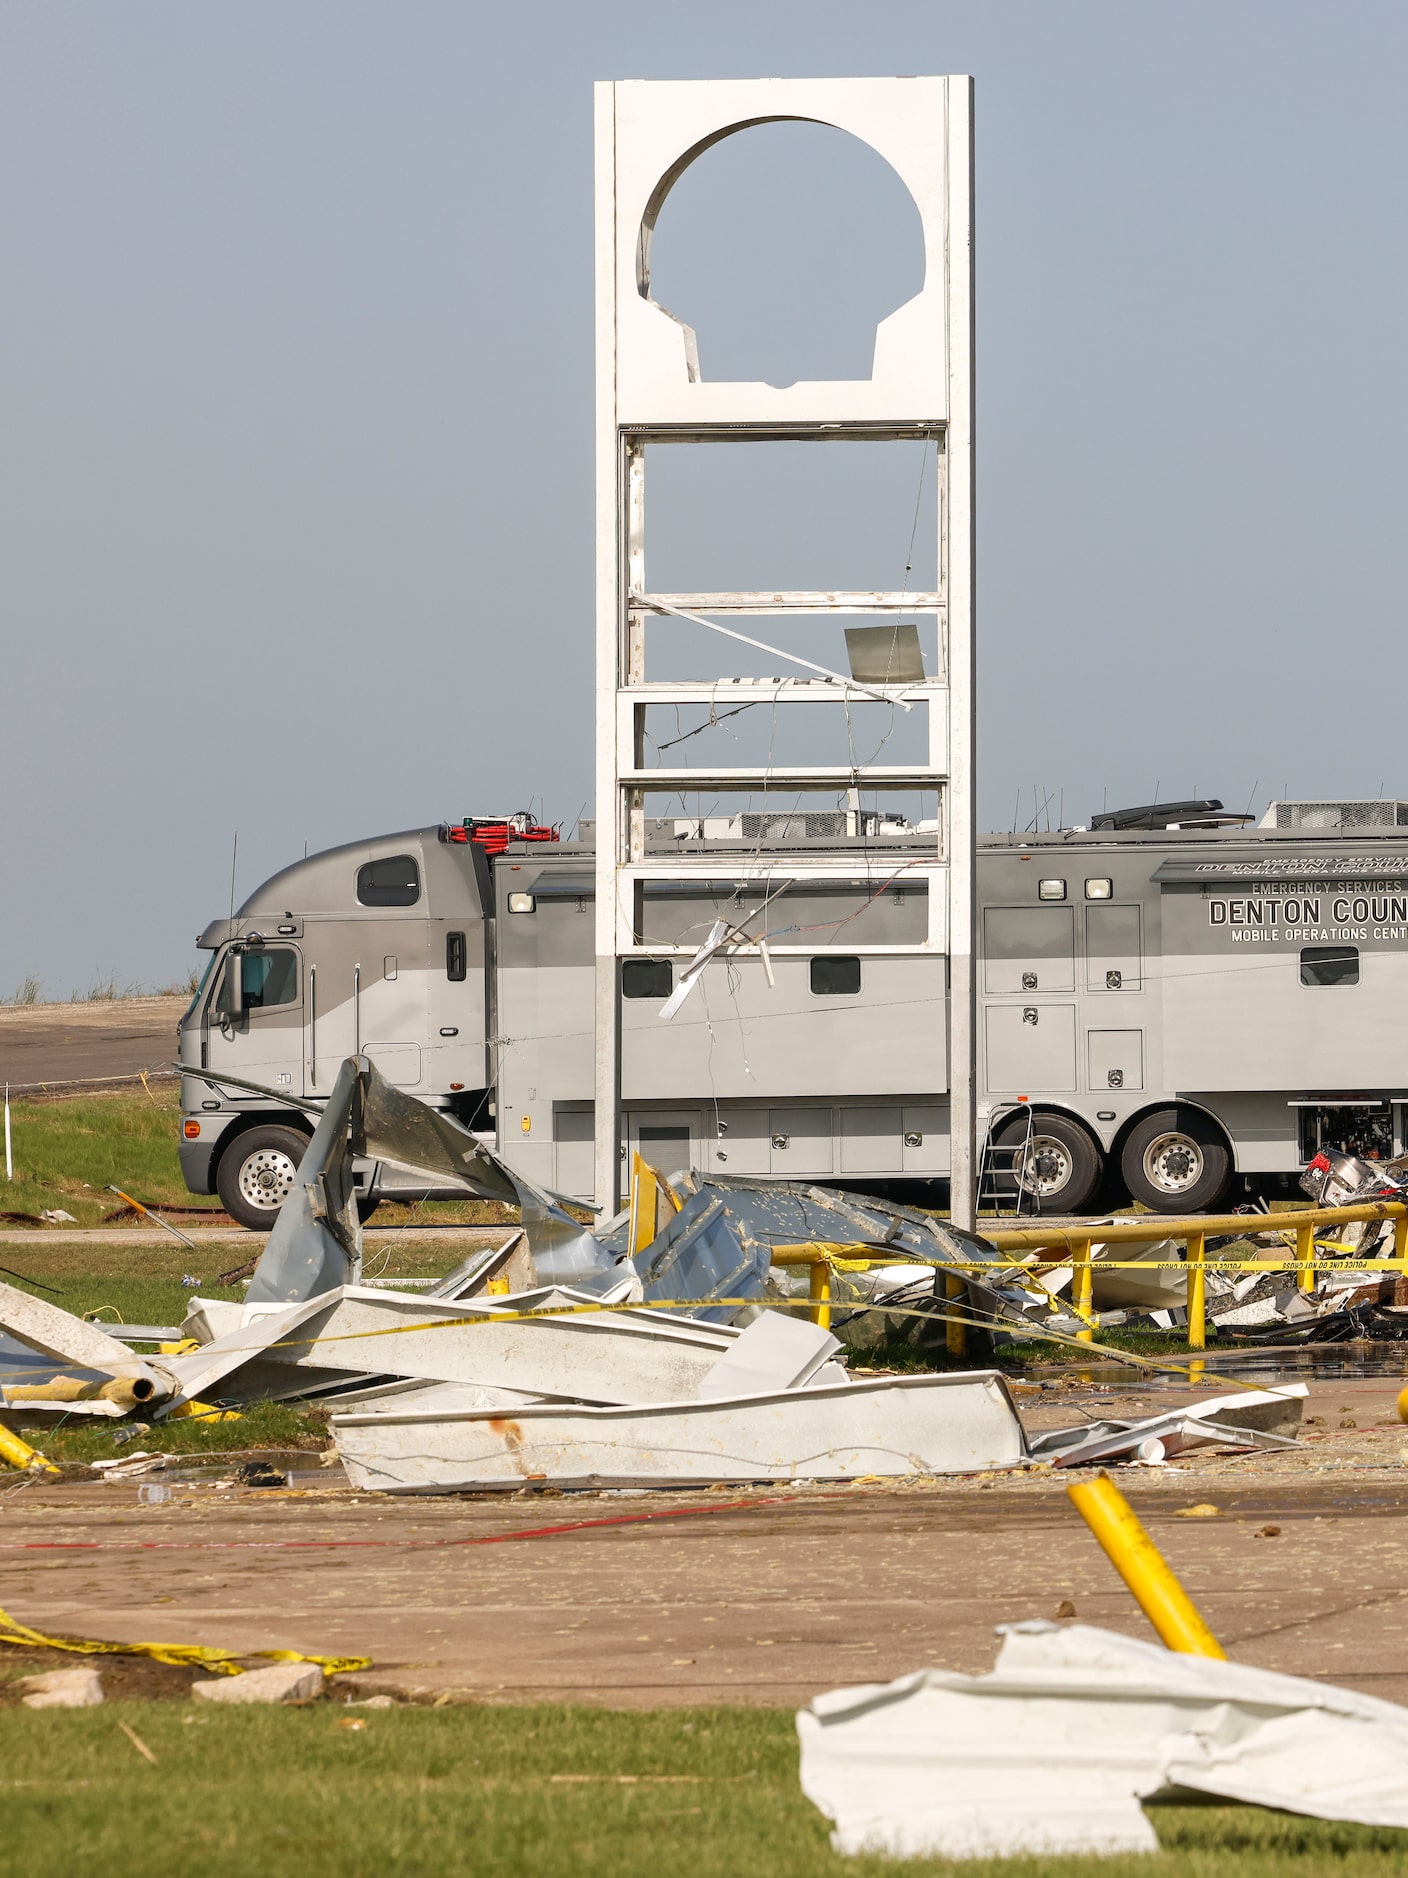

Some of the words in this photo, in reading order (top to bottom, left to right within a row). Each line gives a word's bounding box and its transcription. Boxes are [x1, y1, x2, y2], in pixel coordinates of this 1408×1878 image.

[1195, 862, 1327, 872] DENTON
[1252, 882, 1331, 895] EMERGENCY
[1337, 880, 1402, 894] SERVICES
[1209, 898, 1321, 926] DENTON
[1231, 929, 1279, 942] MOBILE
[1285, 928, 1368, 941] OPERATIONS
[1281, 1262, 1303, 1270] CROSS
[1318, 1261, 1328, 1269] DO
[1328, 1261, 1343, 1269] LINE
[1344, 1260, 1367, 1269] POLICE
